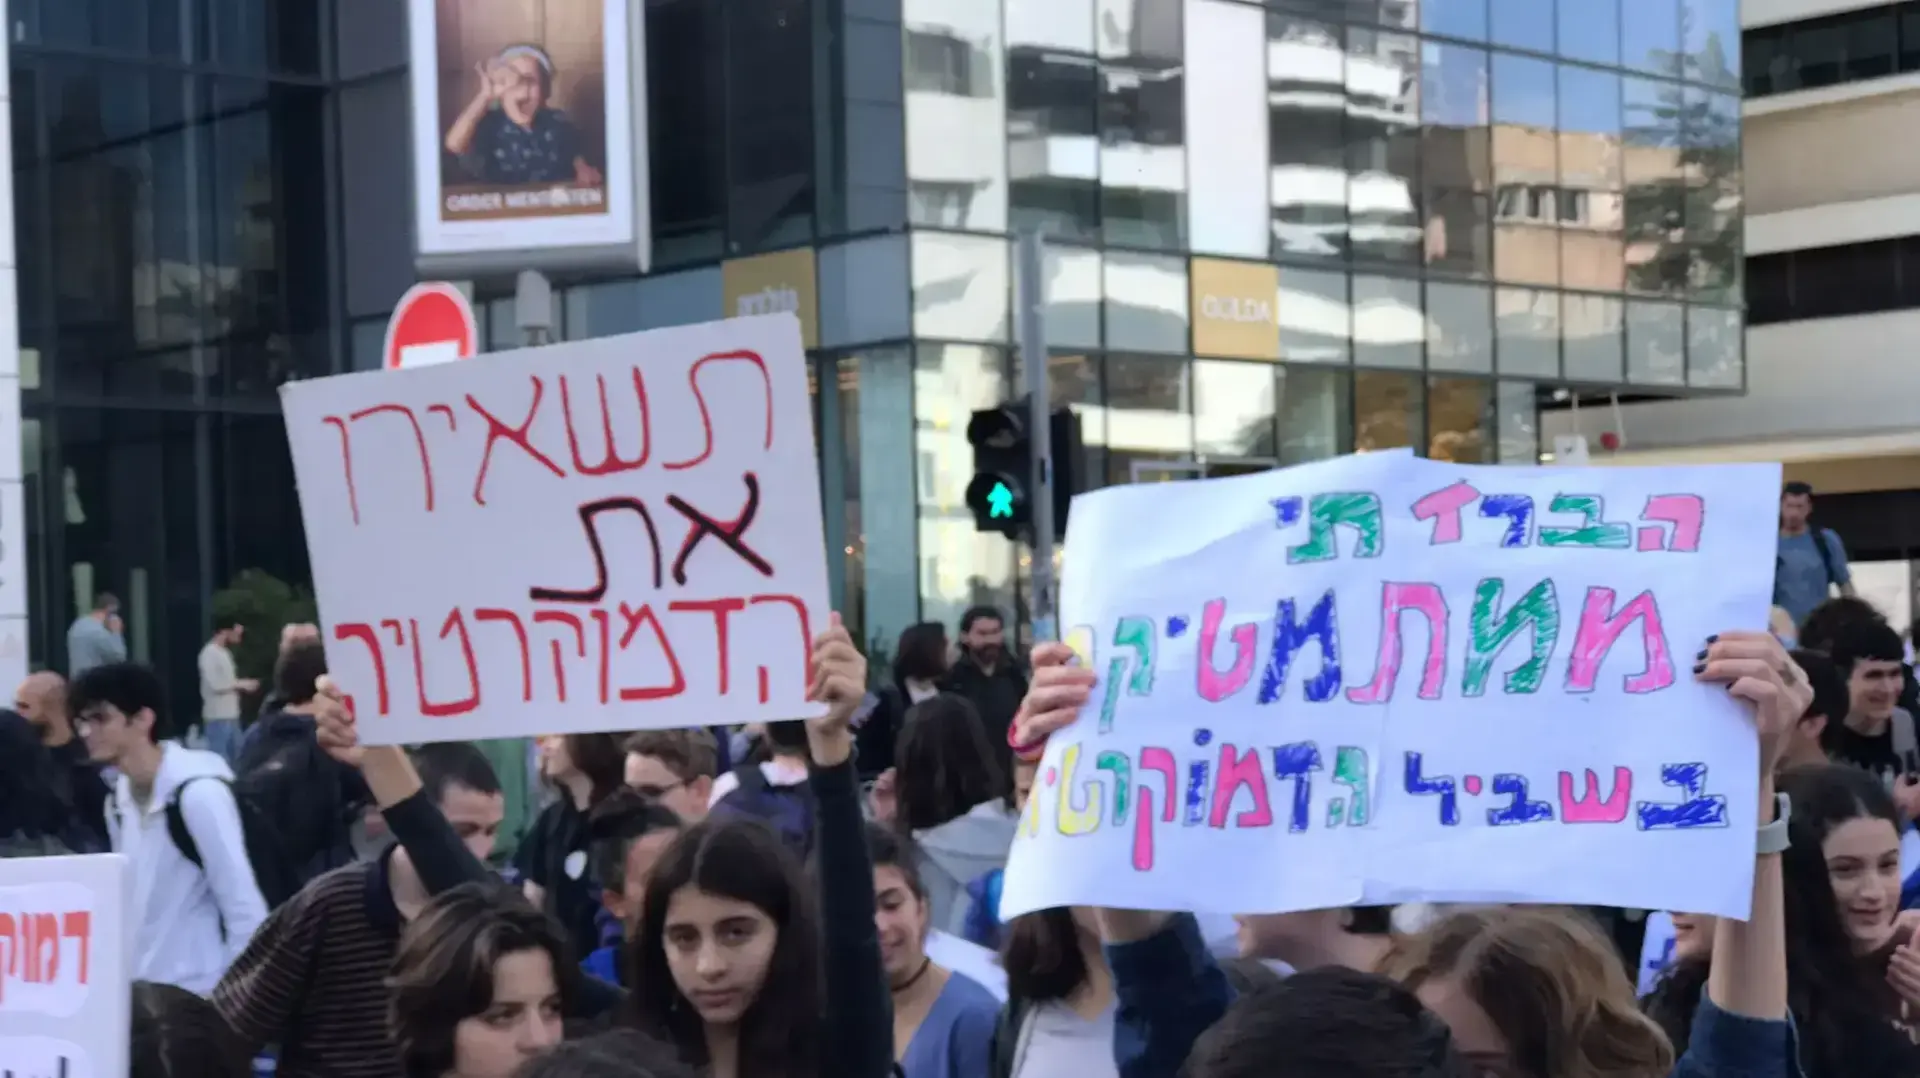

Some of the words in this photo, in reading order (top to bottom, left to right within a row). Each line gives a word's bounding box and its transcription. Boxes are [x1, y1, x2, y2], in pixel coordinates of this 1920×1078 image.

[322, 348, 773, 526] תשאירו
[529, 471, 775, 603] את
[334, 593, 815, 727] הדמוקרטיה
[1404, 750, 1730, 831] בשביל
